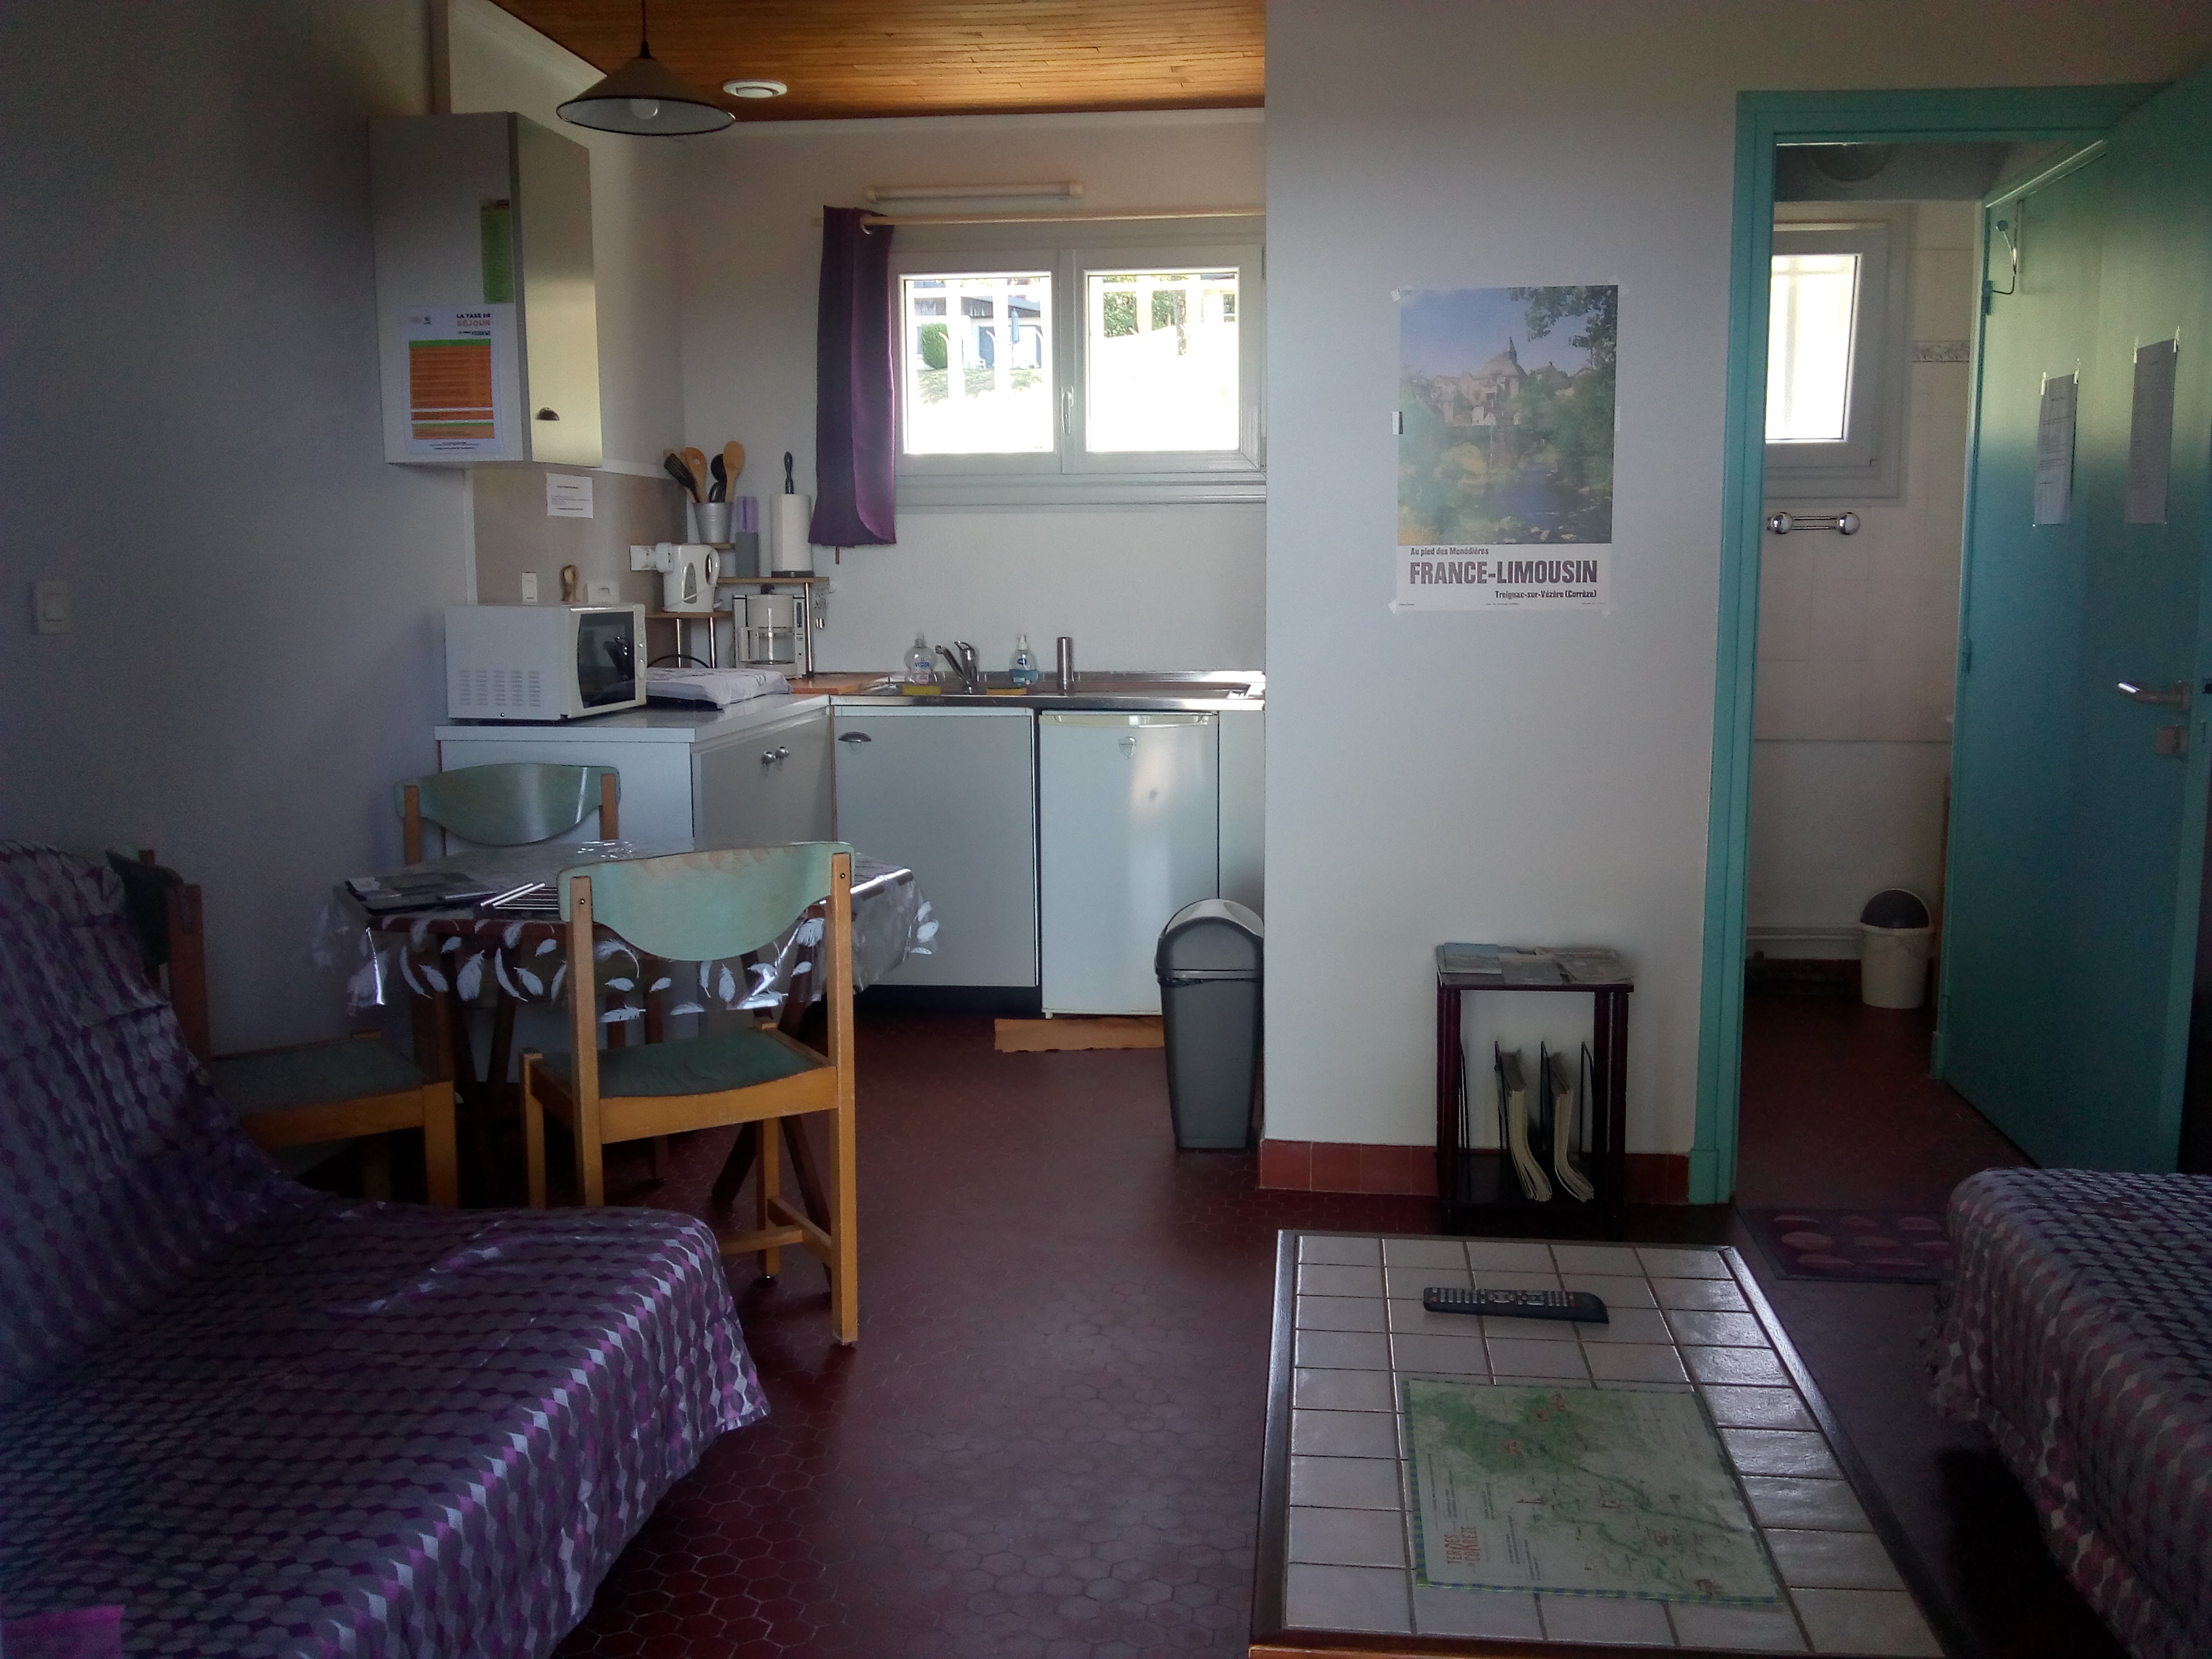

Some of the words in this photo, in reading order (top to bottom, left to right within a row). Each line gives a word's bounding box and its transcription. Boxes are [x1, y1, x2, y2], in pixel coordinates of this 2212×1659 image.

[1420, 548, 1435, 556] pied
[1410, 560, 1597, 584] FRANCE-LIMOUSIN
[1565, 590, 1597, 598] (Corrèze)
